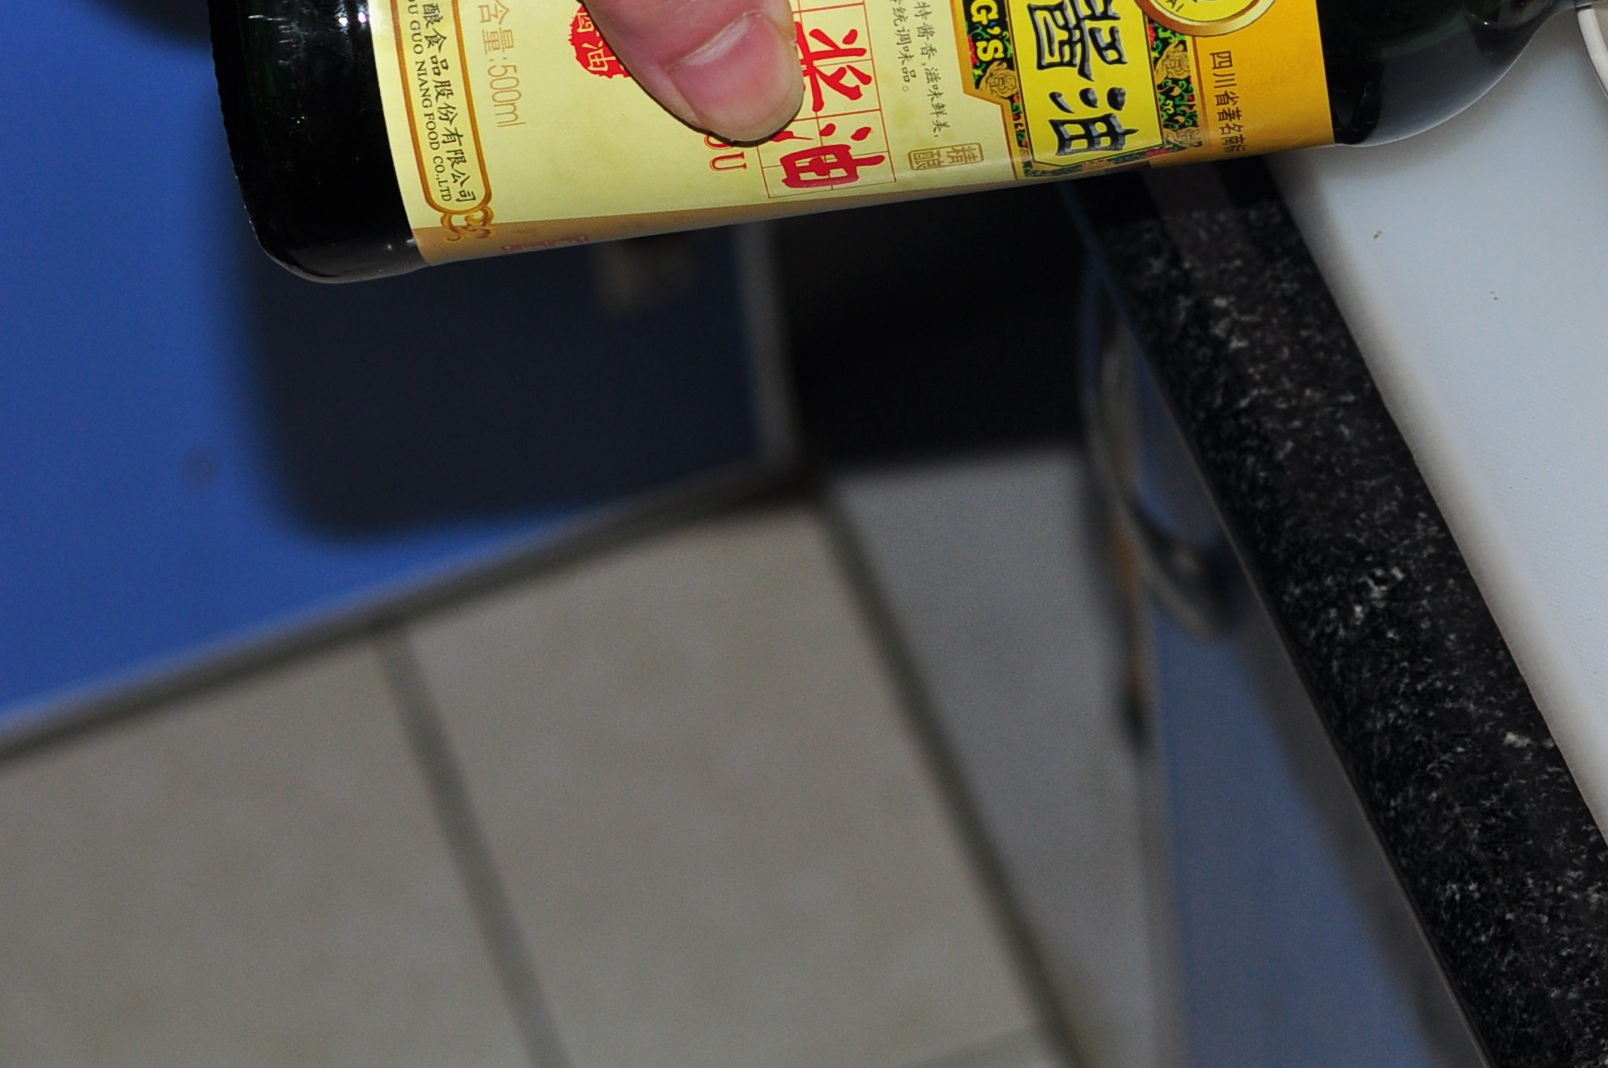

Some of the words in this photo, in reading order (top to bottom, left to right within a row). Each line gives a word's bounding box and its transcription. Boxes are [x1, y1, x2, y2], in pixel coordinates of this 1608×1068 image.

[409, 19, 424, 55] GUO
[415, 59, 433, 109] NIANG
[423, 112, 441, 151] FOOD
